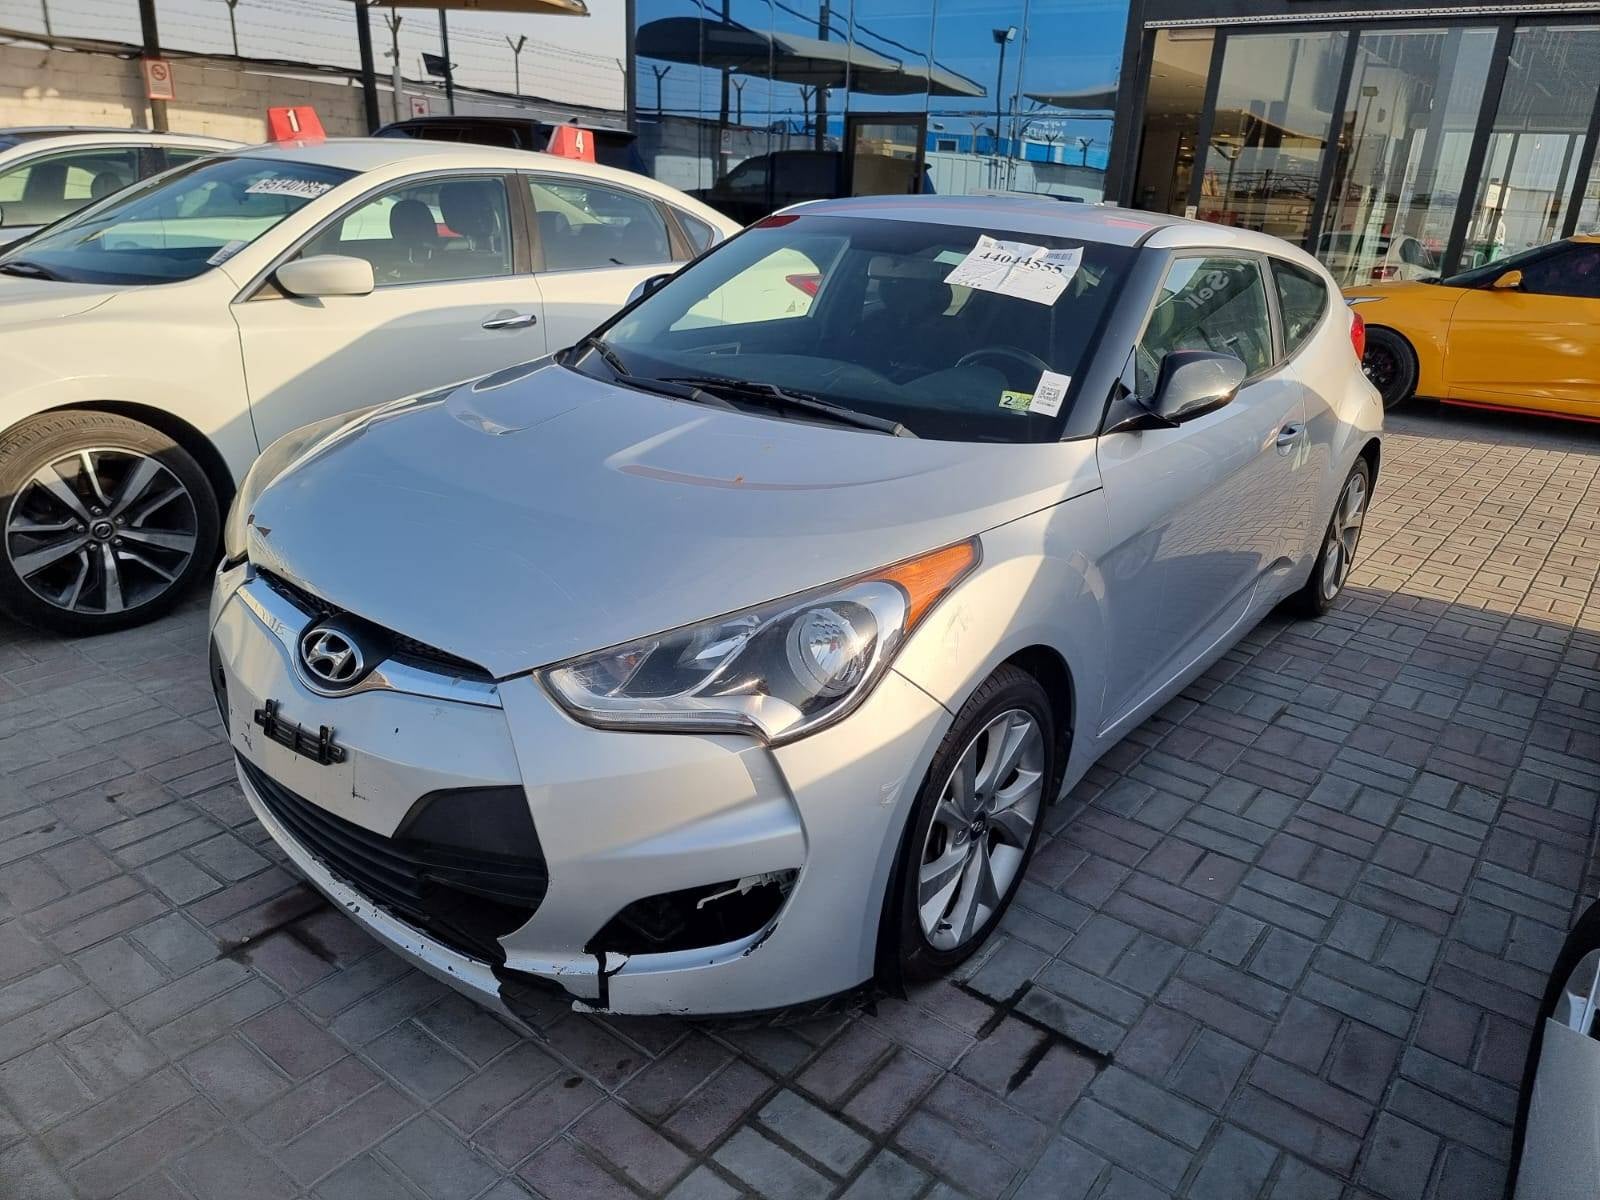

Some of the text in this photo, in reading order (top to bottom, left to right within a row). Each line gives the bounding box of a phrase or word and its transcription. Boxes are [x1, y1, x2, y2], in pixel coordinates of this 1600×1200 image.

[287, 109, 300, 132] 1
[575, 131, 584, 153] 4
[979, 251, 1065, 275] 44044555
